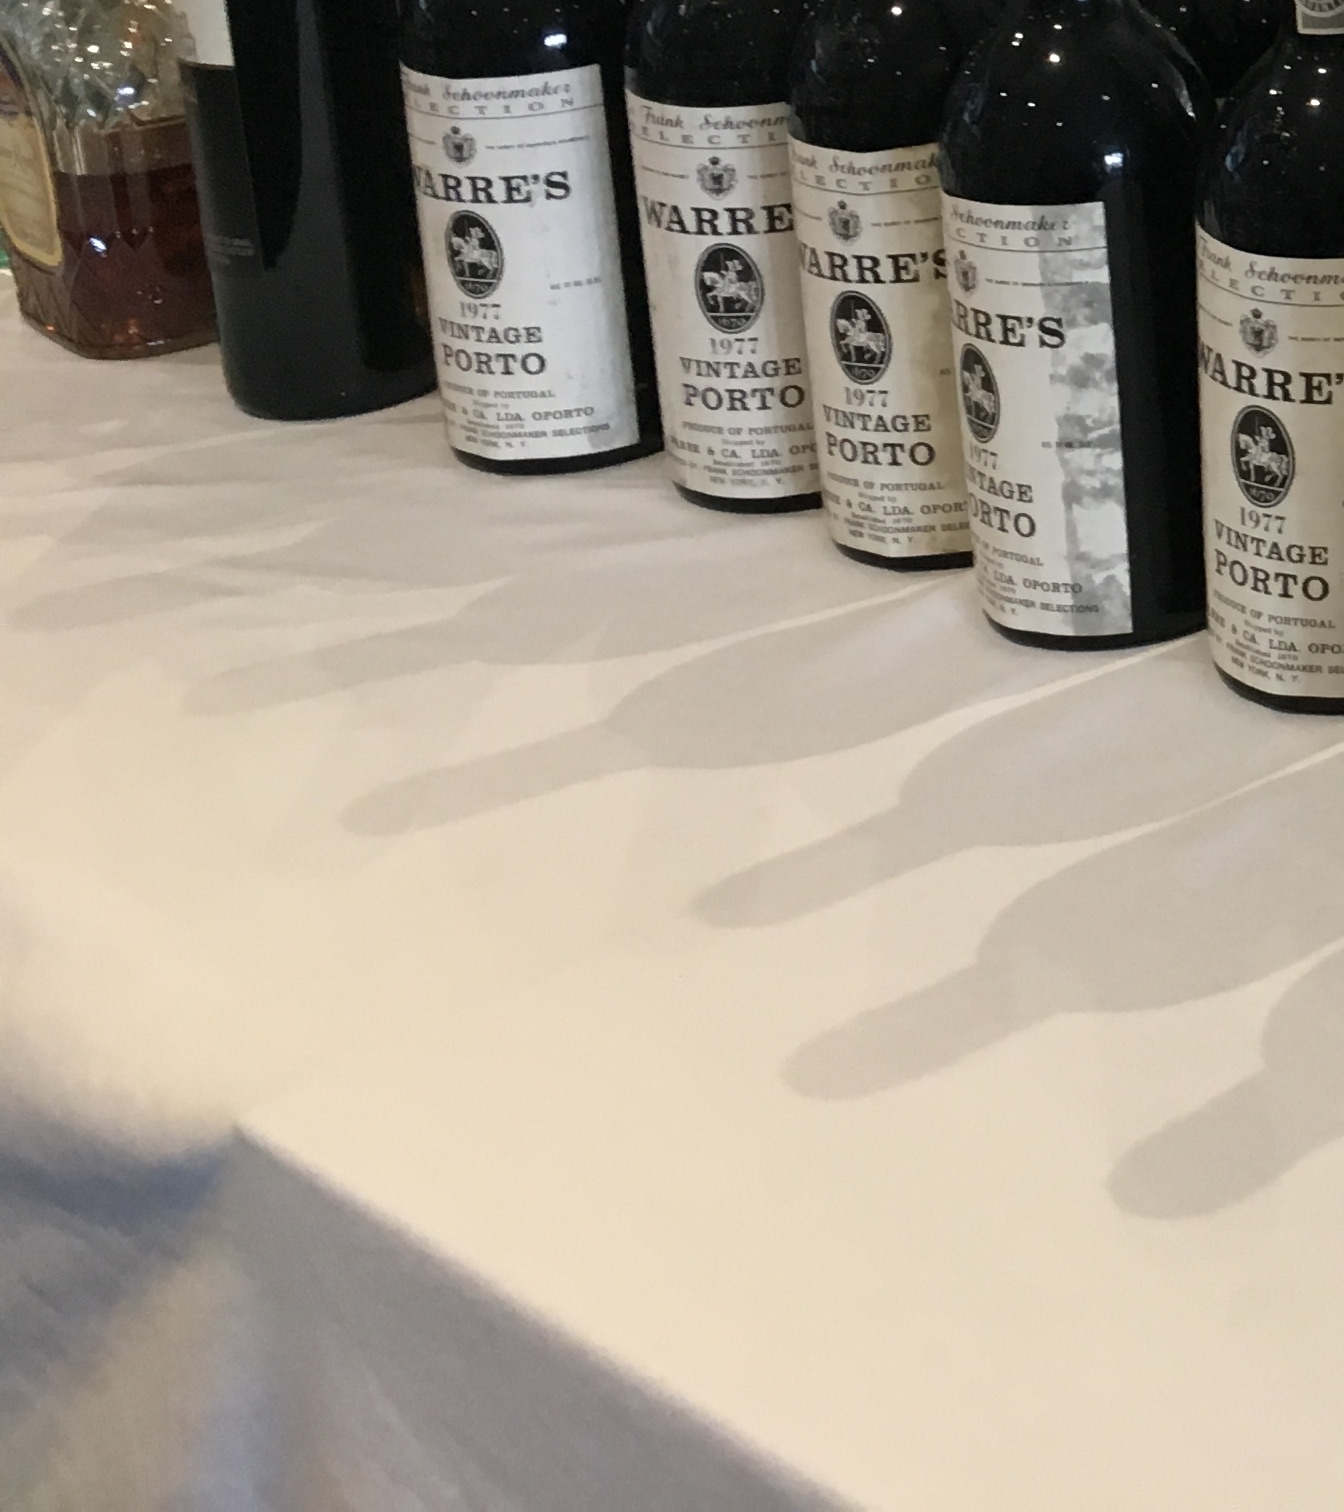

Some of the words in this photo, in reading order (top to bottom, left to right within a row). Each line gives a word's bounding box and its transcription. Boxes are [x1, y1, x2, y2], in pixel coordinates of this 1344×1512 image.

[443, 81, 571, 101] Schoonmaker
[641, 195, 794, 236] WARRE
[459, 302, 501, 320] 1977
[438, 317, 543, 344] VINTAGE
[709, 337, 758, 355] 1977
[442, 344, 546, 375] PORTO
[679, 357, 802, 379] VINTAGE
[494, 390, 556, 399] PORTUGAL
[682, 383, 805, 412] PORTO
[845, 387, 889, 407] 1977
[531, 406, 595, 421] OPORTO
[822, 404, 932, 433] VINTAGE
[748, 422, 814, 435] PORTUGAL
[825, 431, 936, 466] PORTO
[969, 442, 998, 470] 1977
[880, 481, 943, 491] PORTUGAL
[1240, 506, 1286, 535] 1977
[1214, 518, 1329, 566] VINTAGE
[1023, 578, 1083, 594] OPORTO
[1215, 548, 1330, 602] PORTO
[1268, 614, 1336, 629] PORTUGAL
